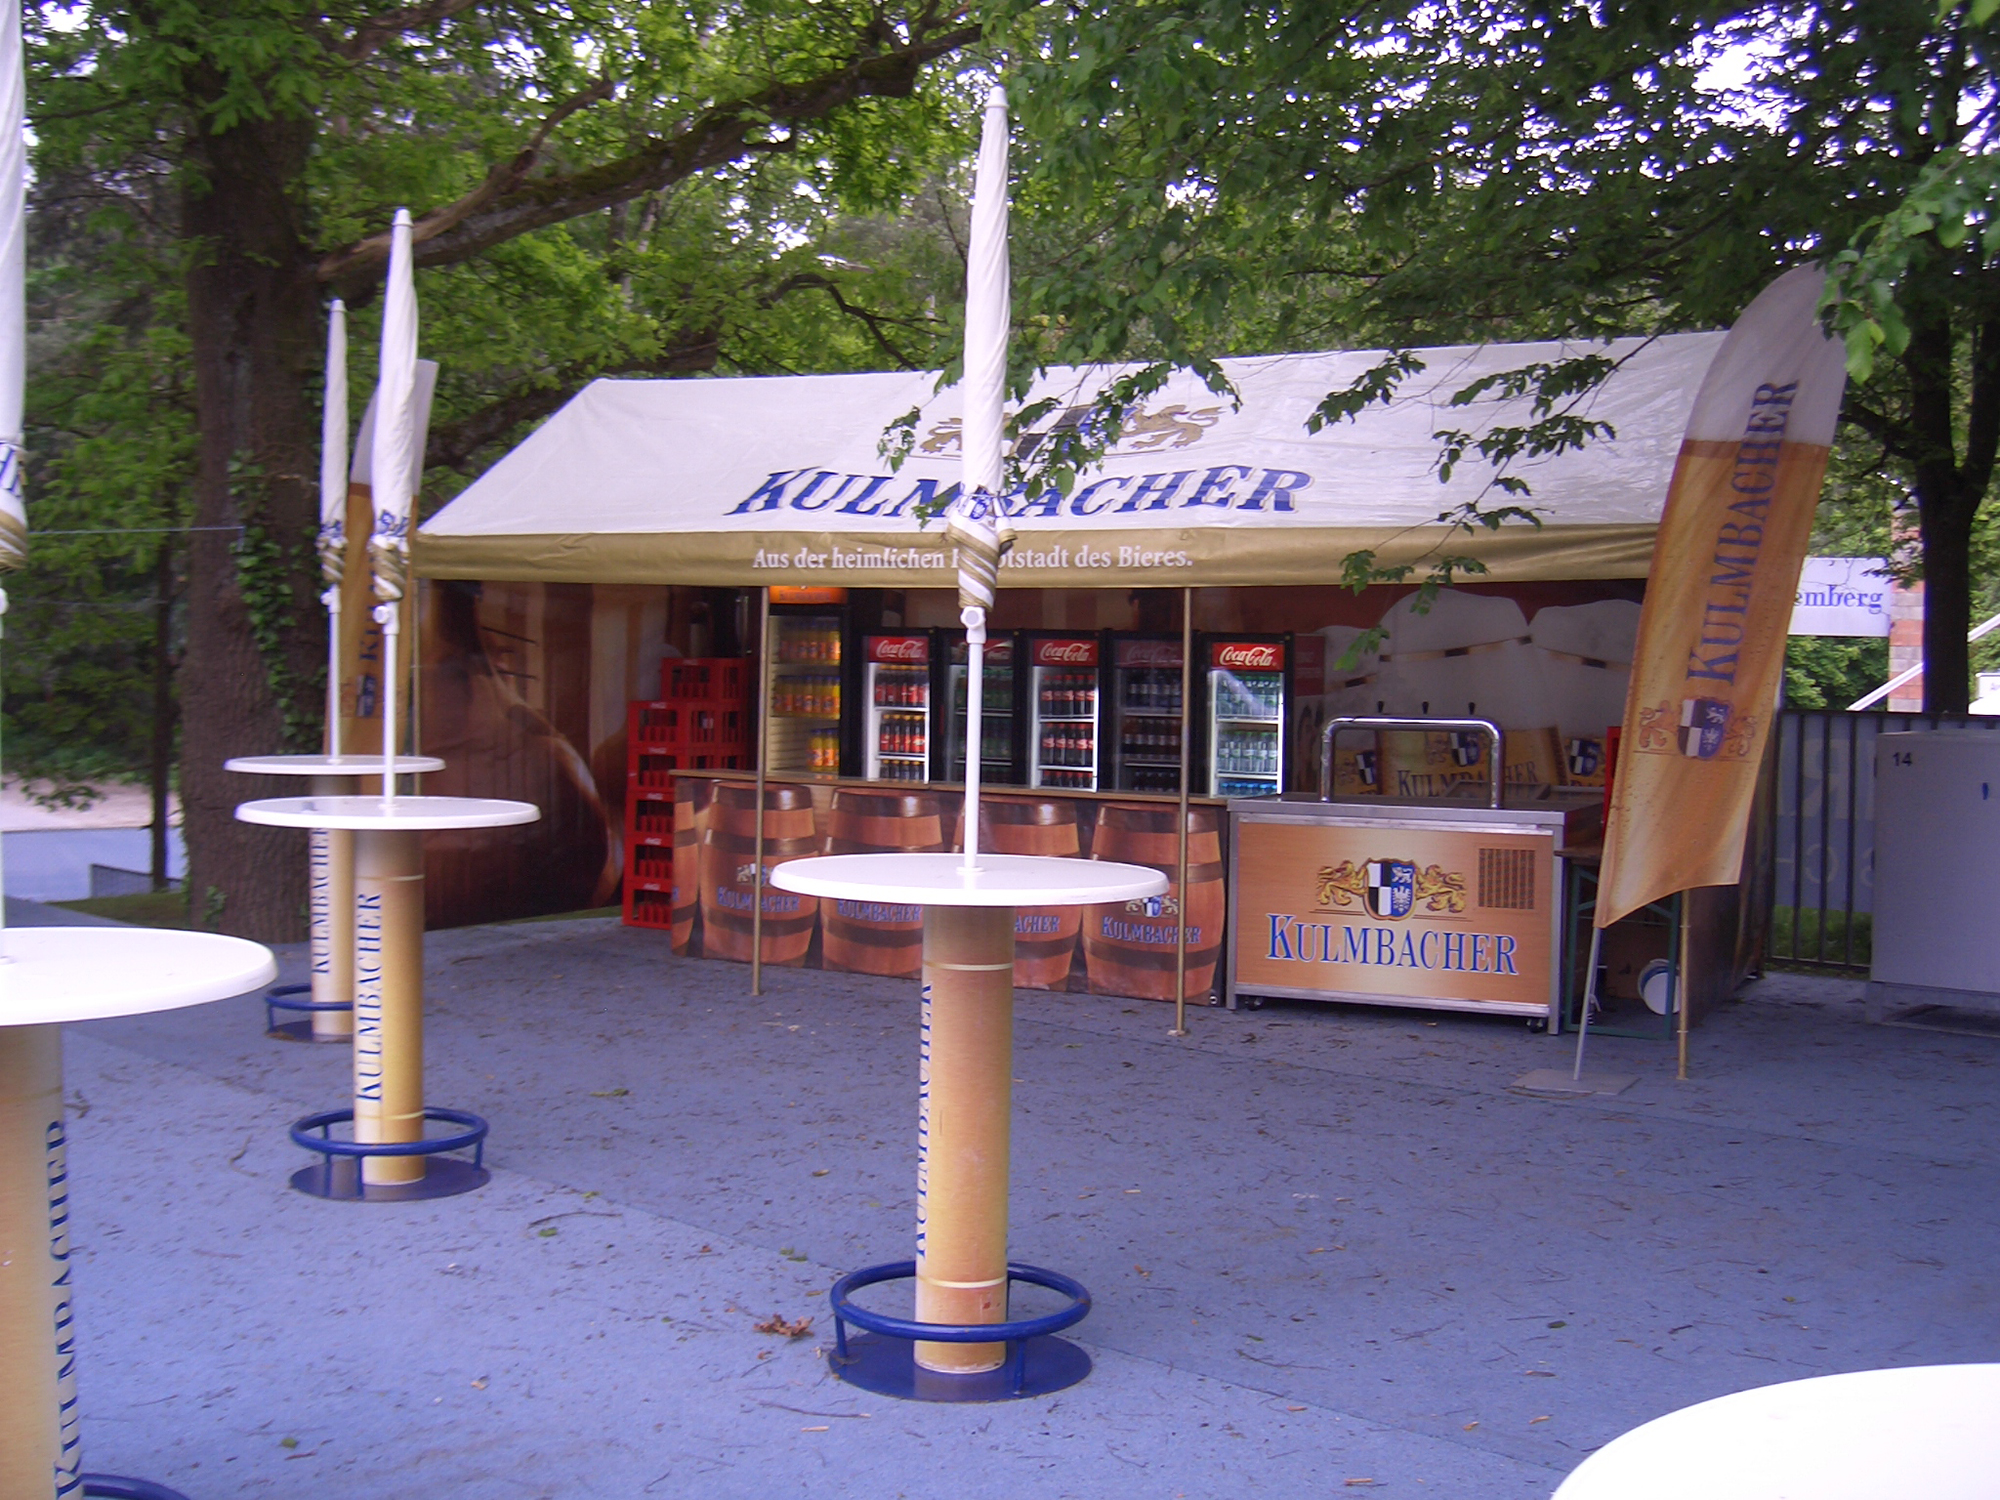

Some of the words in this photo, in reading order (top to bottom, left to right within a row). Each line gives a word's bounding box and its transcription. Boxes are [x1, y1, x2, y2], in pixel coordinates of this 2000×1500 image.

[1686, 379, 1799, 687] KULMBACHER
[752, 548, 790, 569] Aus
[794, 547, 827, 569] der
[831, 547, 945, 569] heimlichen
[1074, 545, 1112, 568] des
[1117, 546, 1193, 568] Bieres.
[876, 640, 925, 659] Coca-Cola
[1040, 642, 1092, 662] Coca-Cola
[1219, 645, 1276, 667] Coca-Cola
[1893, 752, 1912, 767] 14
[717, 886, 799, 913] KULMACHER
[1266, 913, 1519, 976] KULMBACHER
[356, 893, 382, 1102] KULMBACHER
